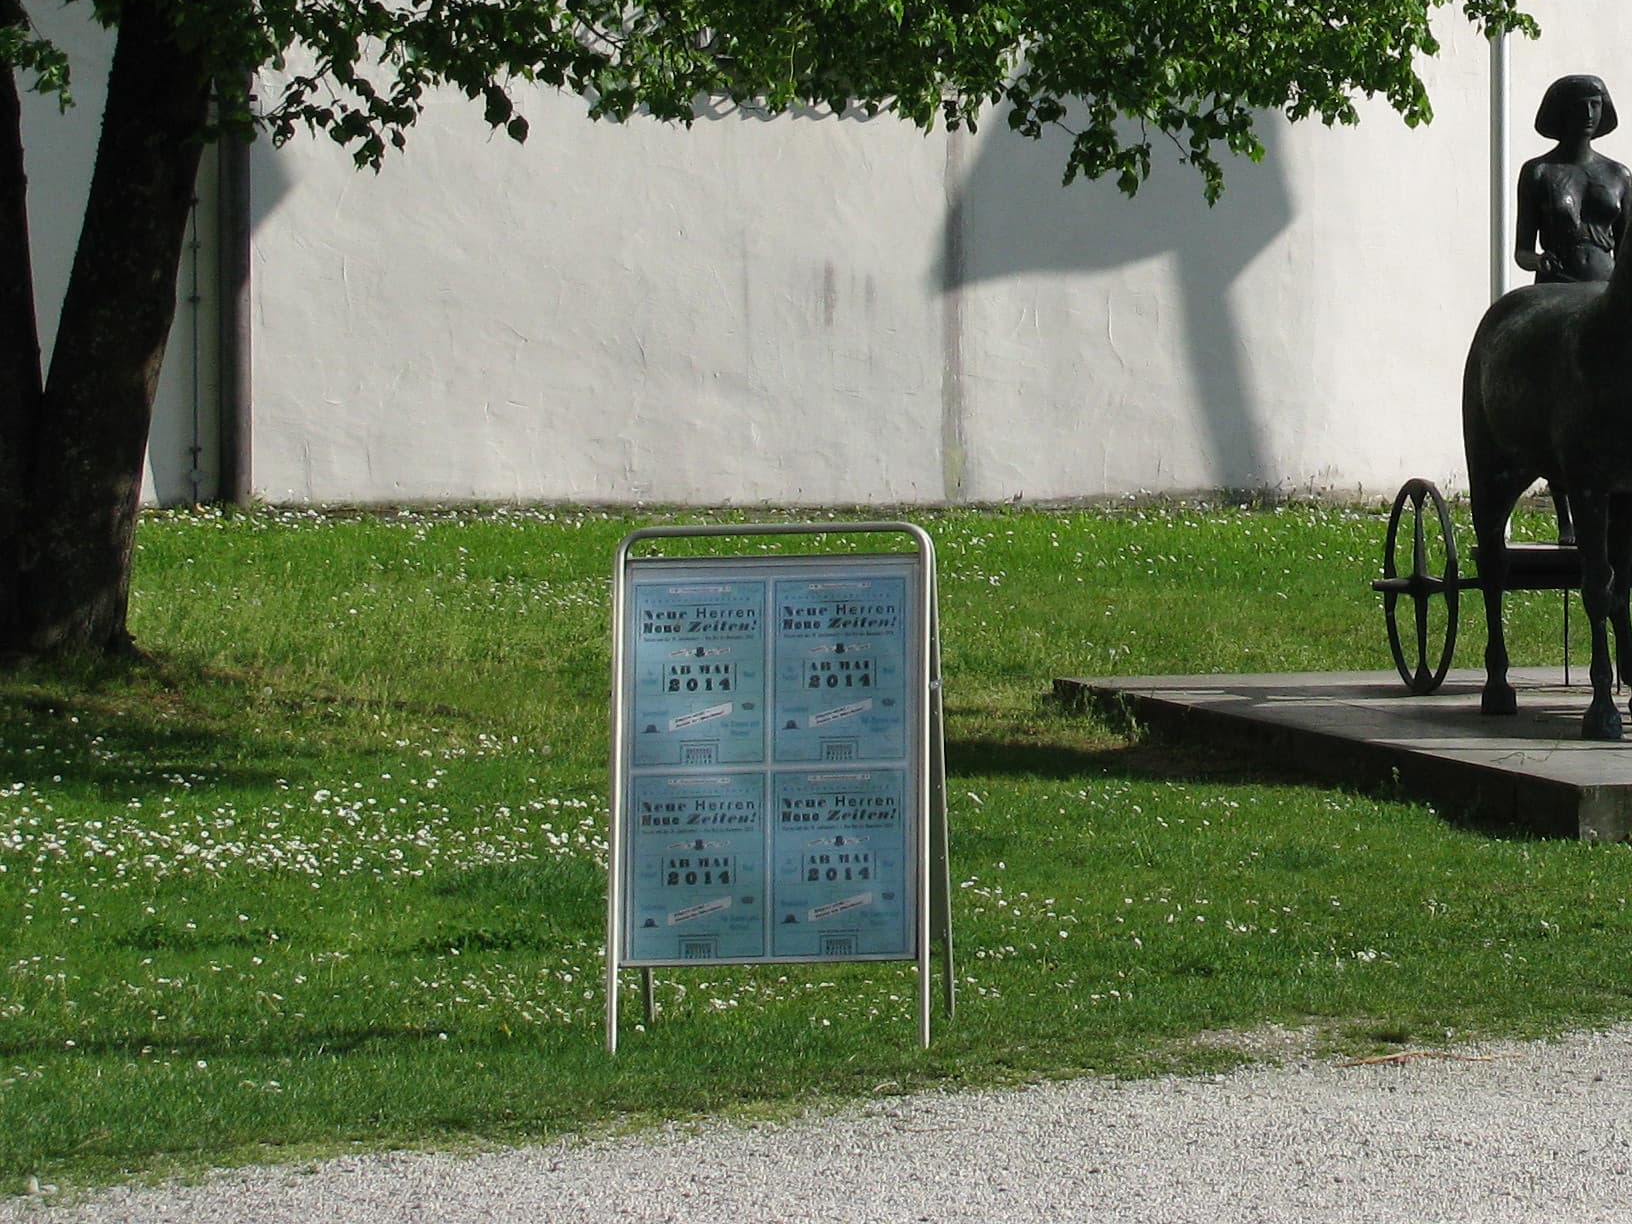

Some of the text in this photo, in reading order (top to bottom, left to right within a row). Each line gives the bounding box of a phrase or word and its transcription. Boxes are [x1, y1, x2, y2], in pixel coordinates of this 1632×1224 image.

[696, 607, 756, 619] Herren
[836, 604, 895, 615] Herren
[668, 678, 731, 692] 2014
[808, 674, 872, 688] 2014
[695, 799, 755, 811] Herren
[835, 795, 895, 807] Herren
[667, 870, 730, 886] 2014
[807, 866, 870, 882] 2014
